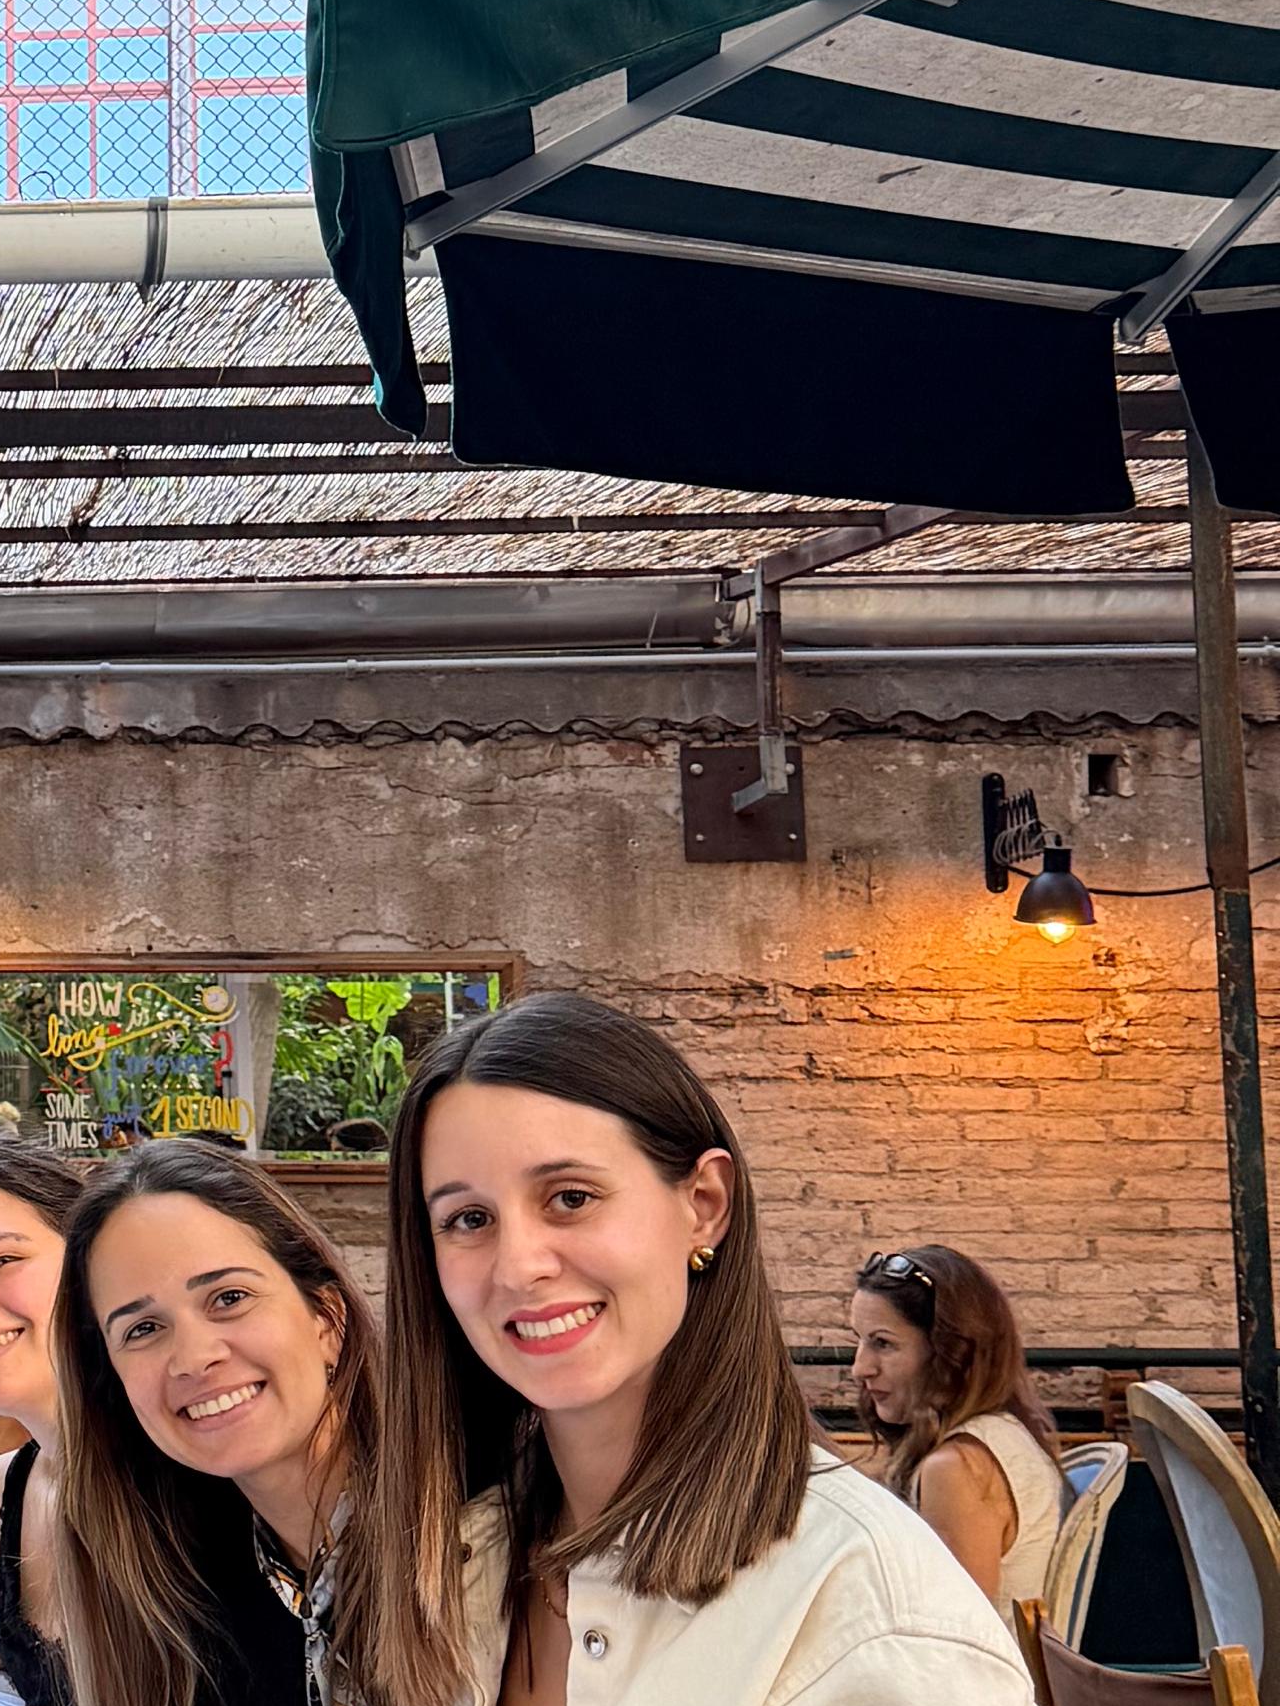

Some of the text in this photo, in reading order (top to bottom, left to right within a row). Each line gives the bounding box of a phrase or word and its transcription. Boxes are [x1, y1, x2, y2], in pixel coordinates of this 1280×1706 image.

[59, 981, 123, 1017] HOW
[39, 1013, 145, 1071] long
[45, 1092, 92, 1120] SOME
[150, 1095, 177, 1138] 1
[175, 1095, 256, 1141] SECOND
[44, 1120, 100, 1149] TIMES
